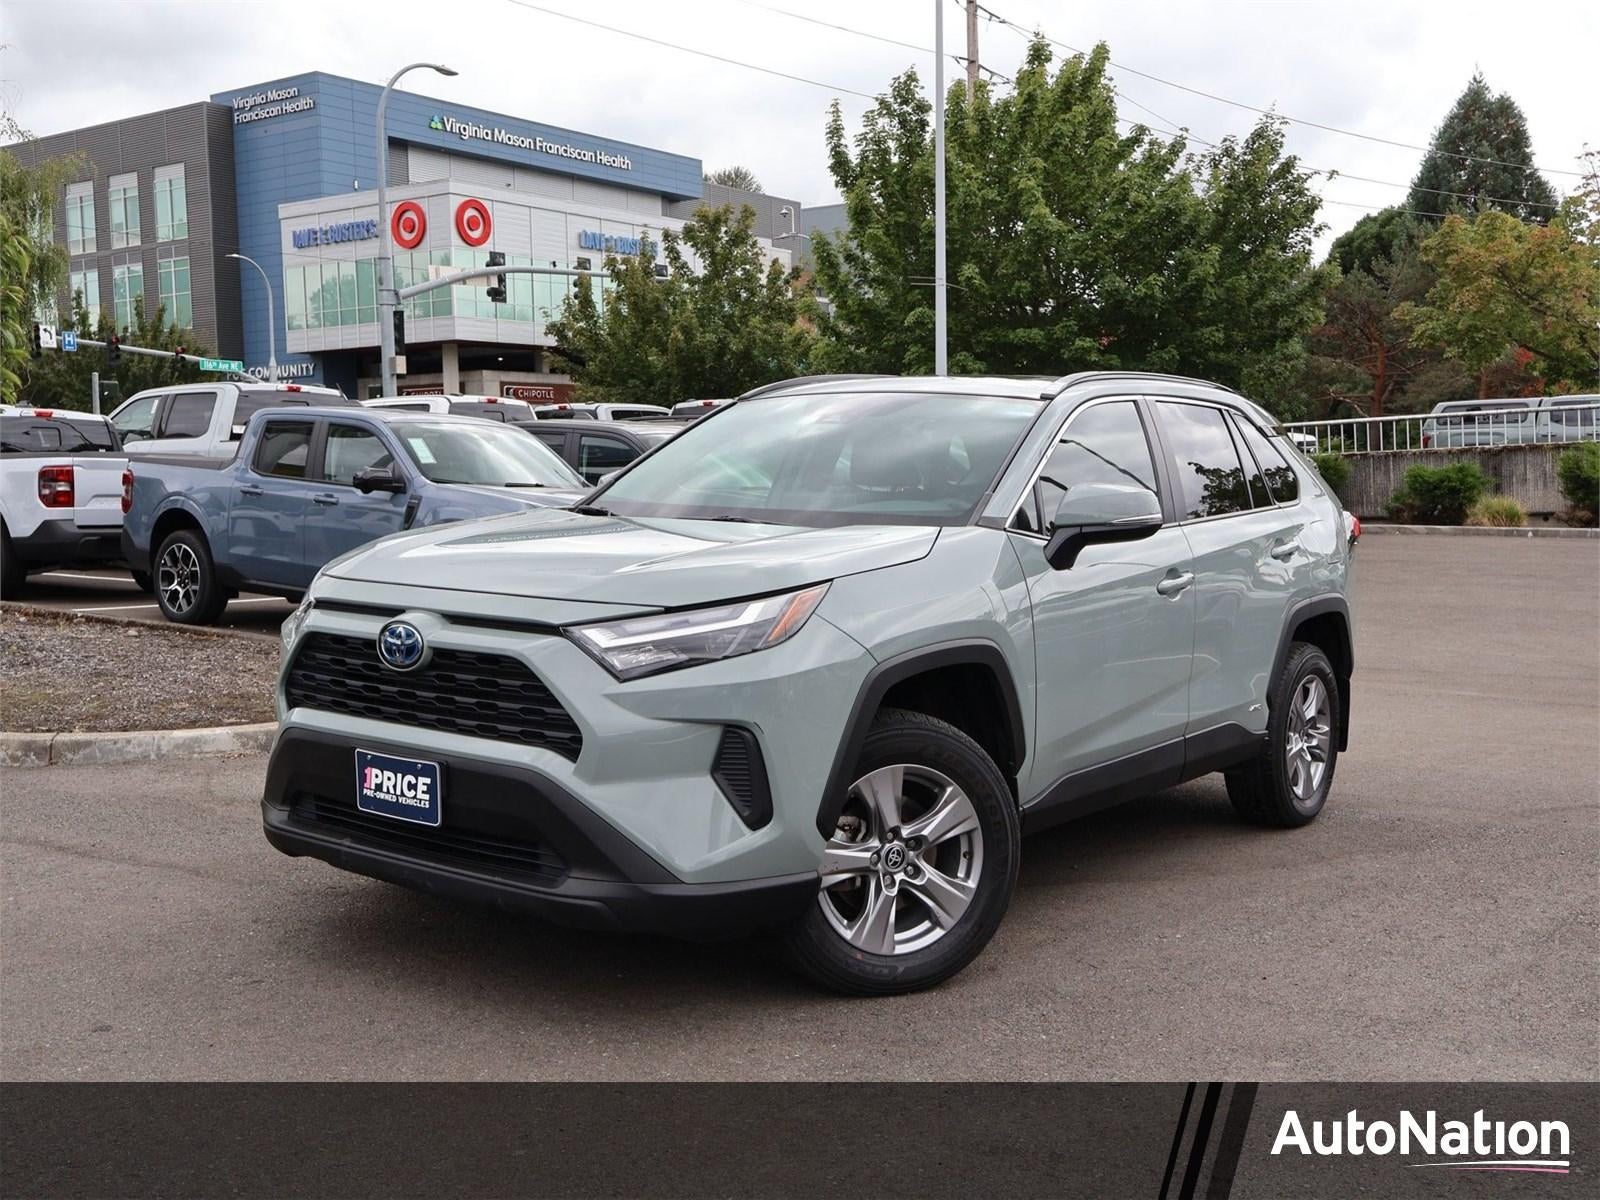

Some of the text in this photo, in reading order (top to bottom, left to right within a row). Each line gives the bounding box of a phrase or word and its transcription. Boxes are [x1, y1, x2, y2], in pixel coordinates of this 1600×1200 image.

[232, 87, 298, 110] Virginia Mason
[234, 96, 314, 124] Franciscan Health
[443, 116, 632, 170] Virginia Mason Franciscan Health
[65, 333, 74, 345] H
[518, 389, 554, 399] CHIPOTLE
[363, 788, 429, 808] PRE-OWNED VEHICLES
